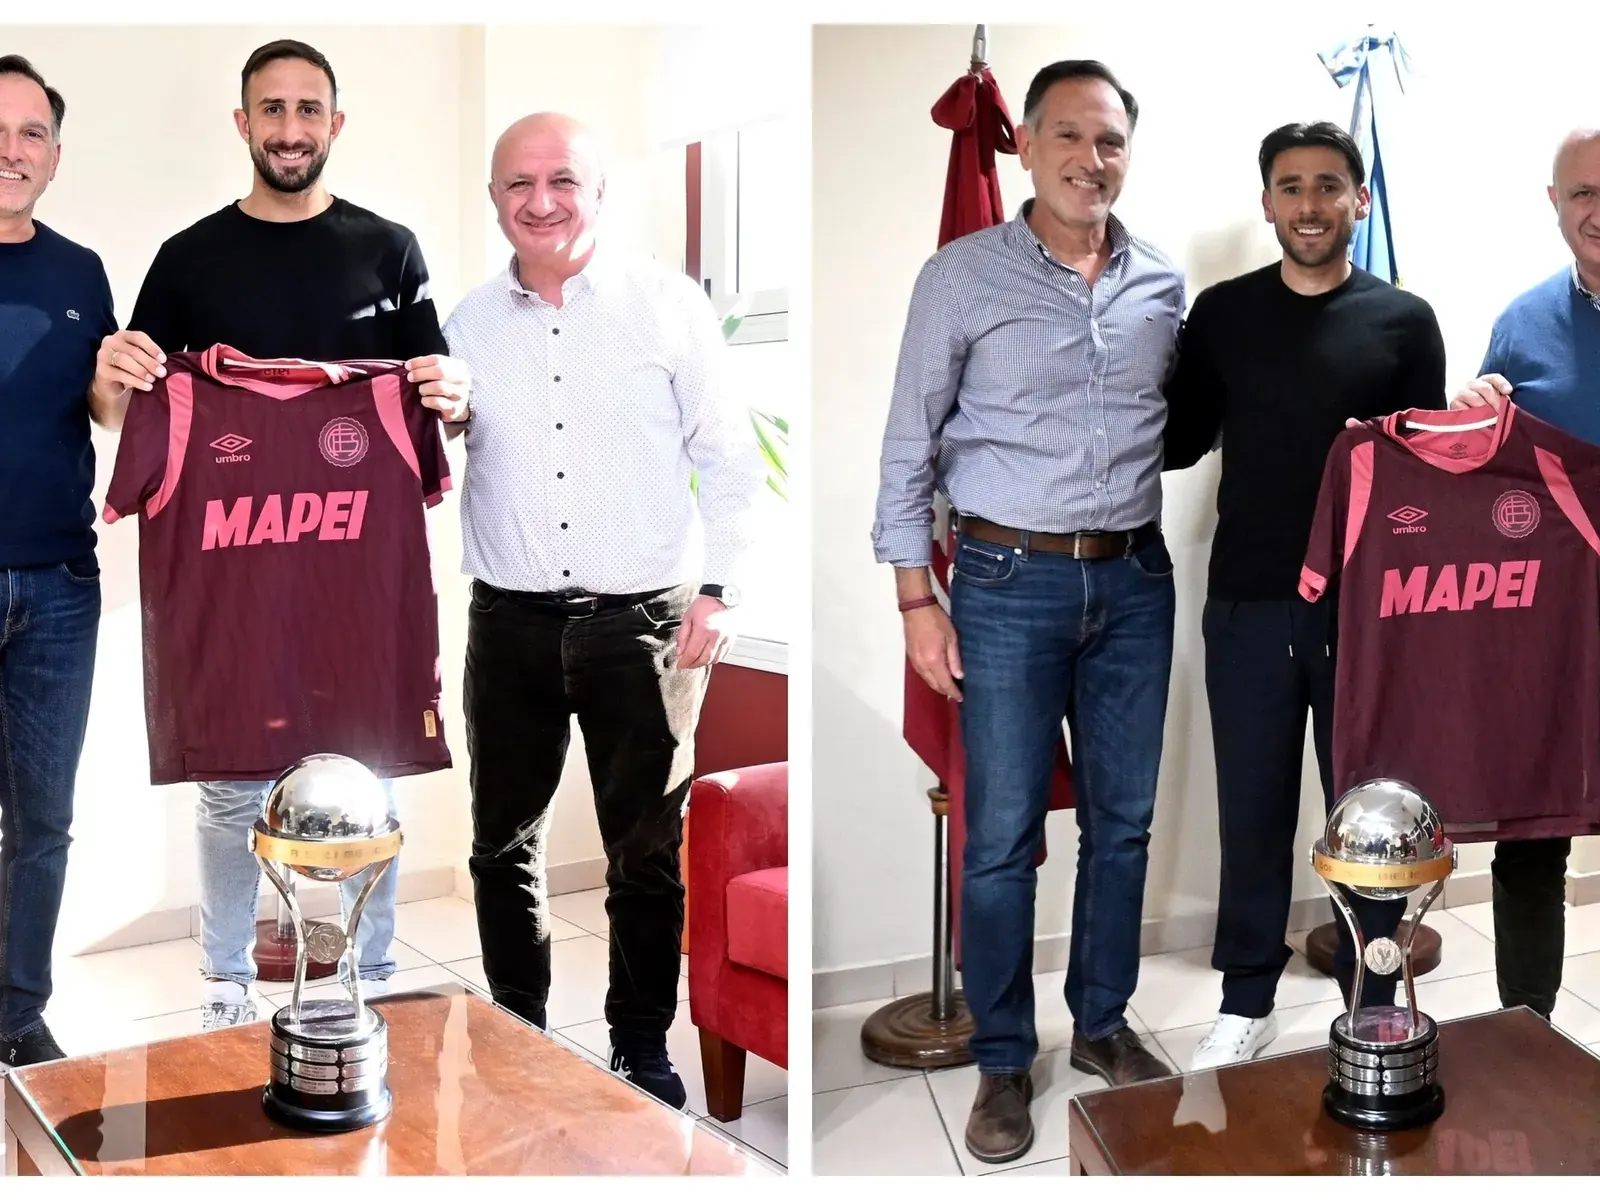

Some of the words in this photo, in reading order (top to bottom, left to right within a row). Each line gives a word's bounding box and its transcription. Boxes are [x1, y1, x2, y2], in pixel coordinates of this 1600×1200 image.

[215, 453, 251, 463] umbro
[201, 490, 369, 551] MAPEI
[1392, 525, 1427, 535] umbro
[1379, 559, 1541, 618] MAPEI
